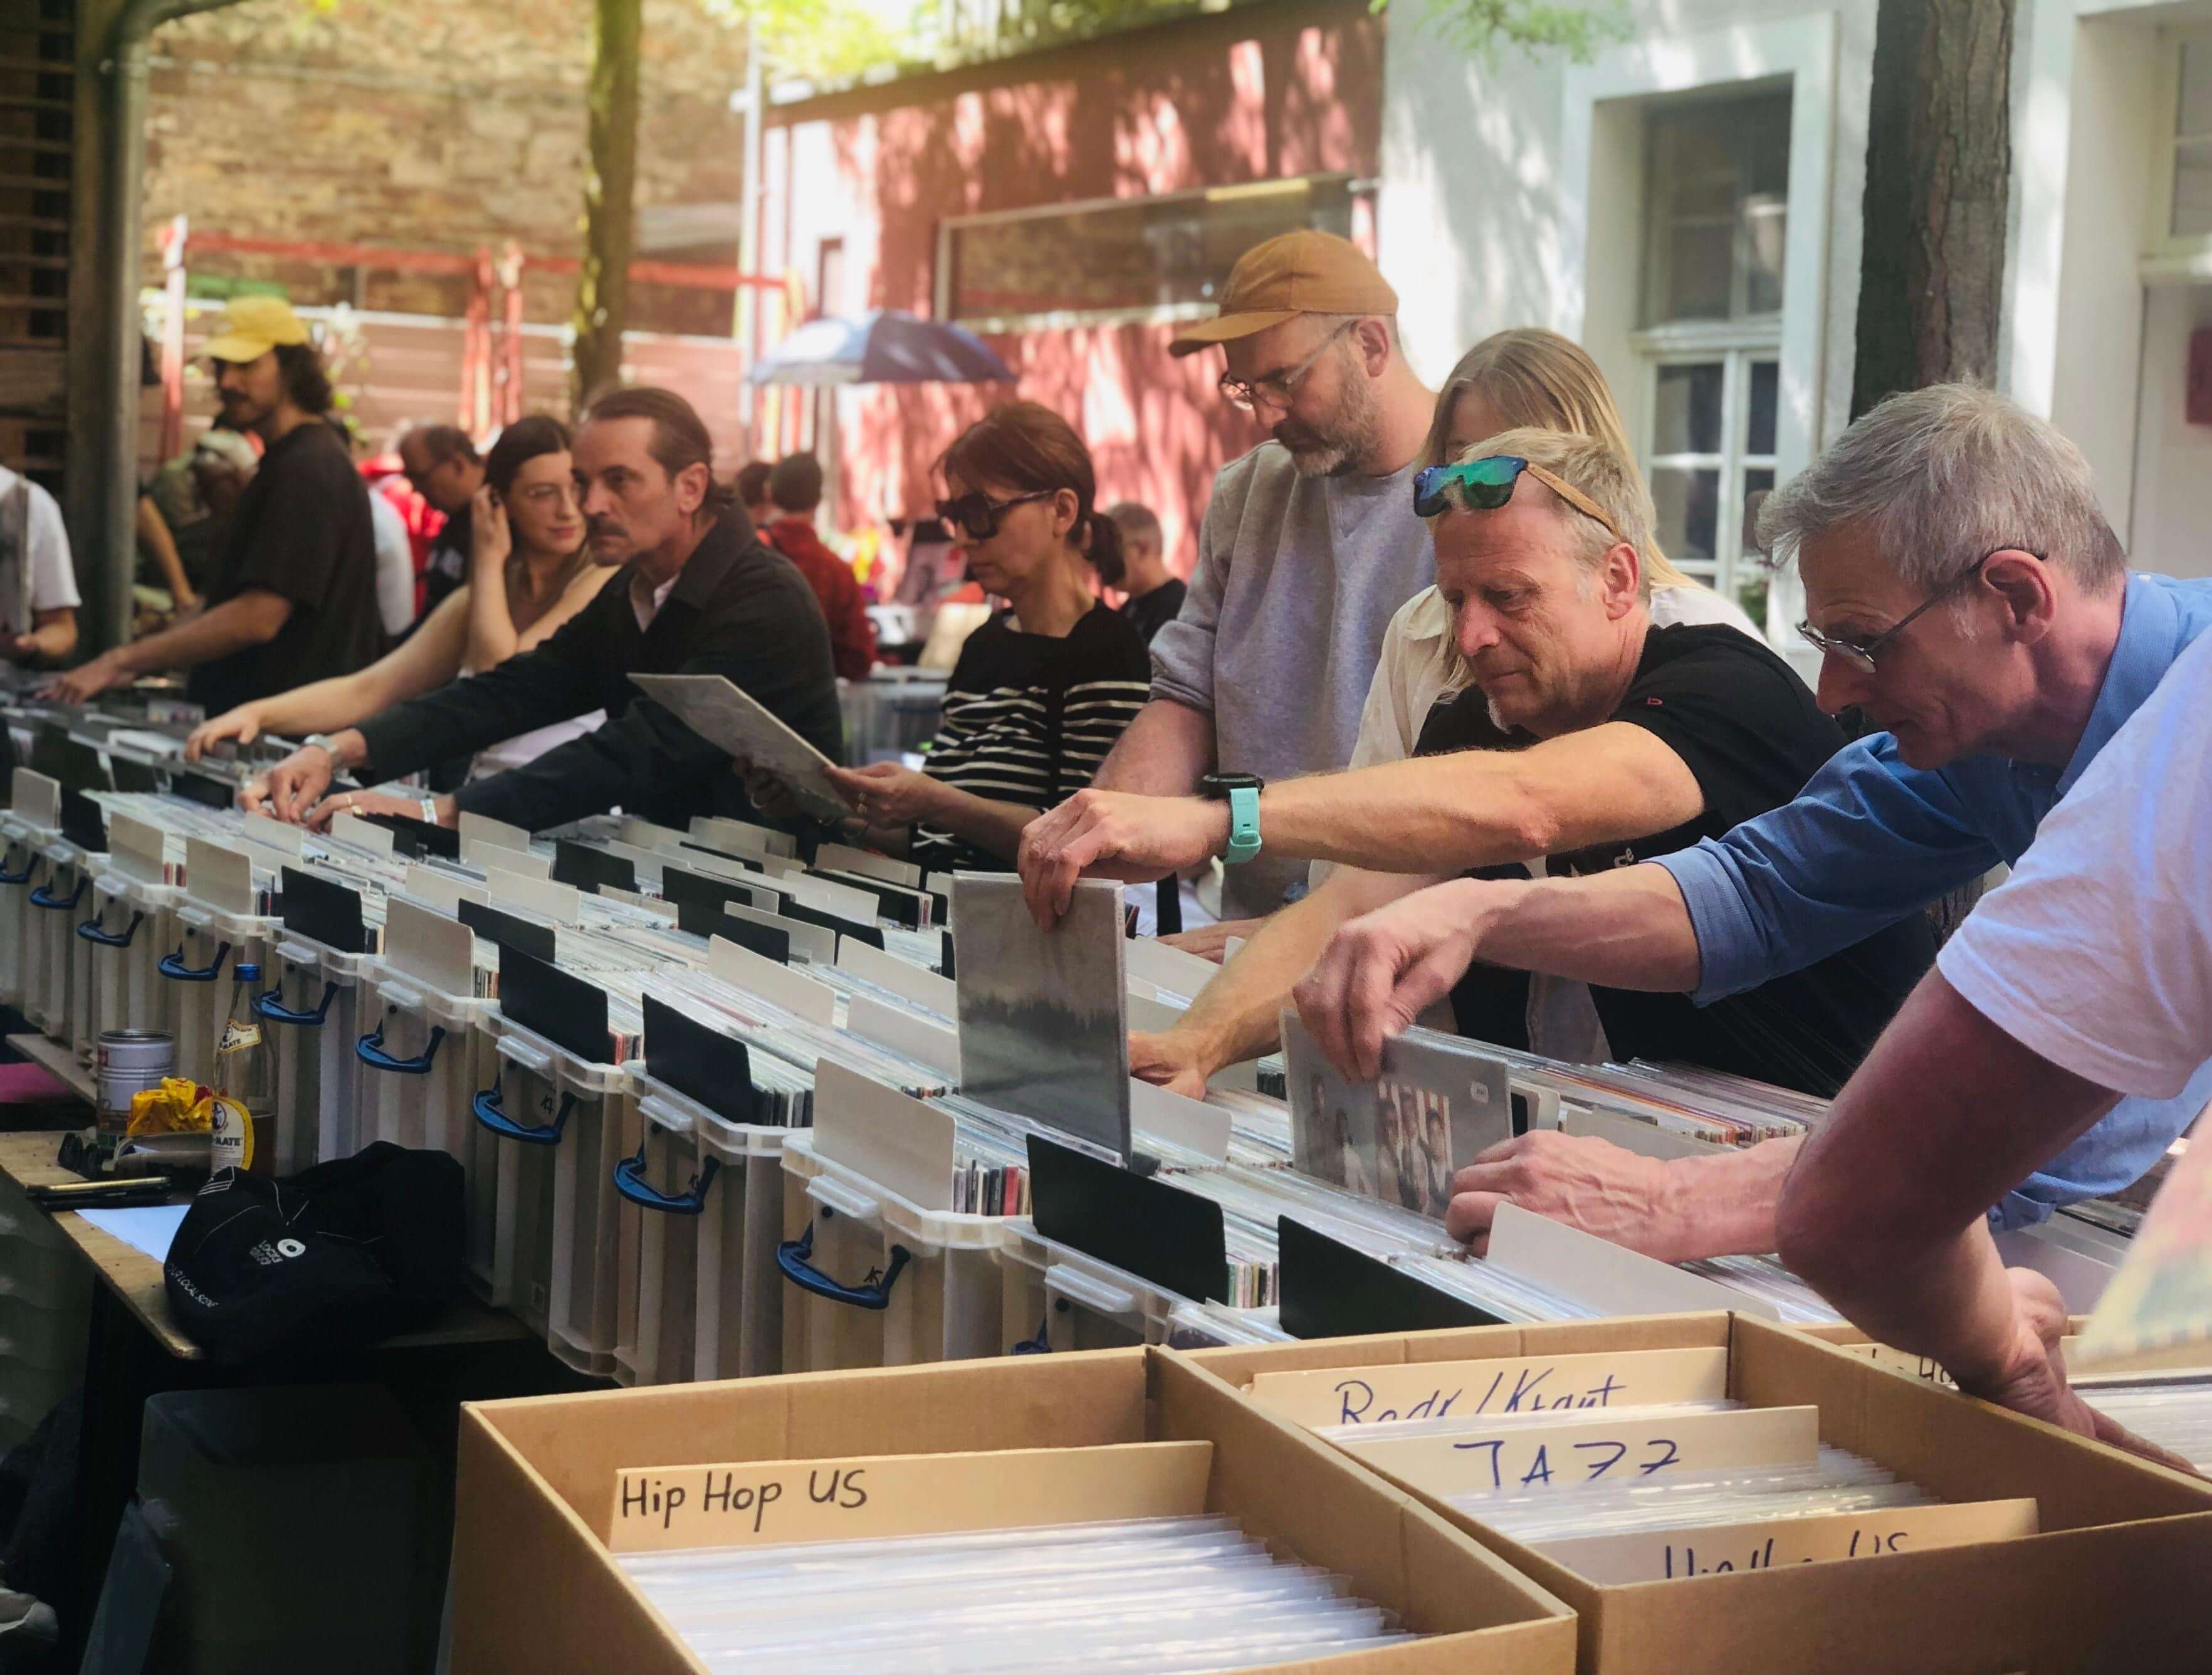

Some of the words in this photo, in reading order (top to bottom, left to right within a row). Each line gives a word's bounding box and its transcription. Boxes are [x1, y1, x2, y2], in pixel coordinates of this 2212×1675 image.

[622, 1476, 685, 1529] Hip
[703, 1471, 782, 1533] Hop
[809, 1469, 867, 1508] US
